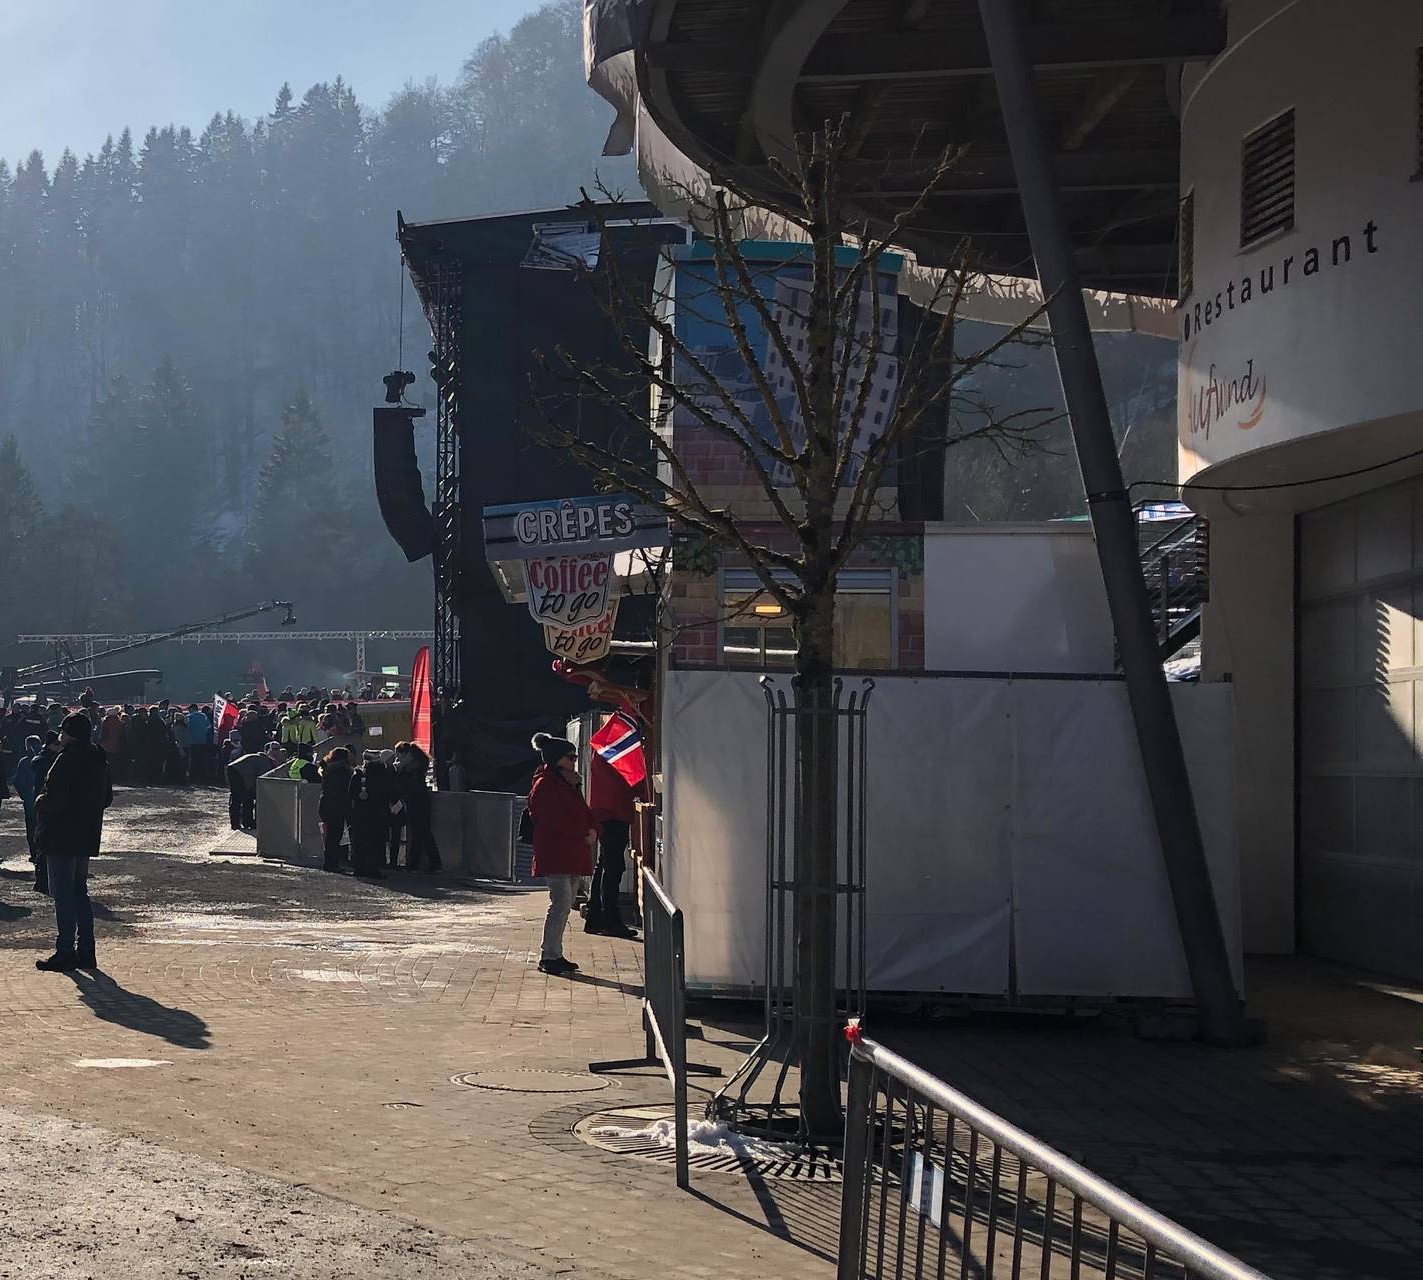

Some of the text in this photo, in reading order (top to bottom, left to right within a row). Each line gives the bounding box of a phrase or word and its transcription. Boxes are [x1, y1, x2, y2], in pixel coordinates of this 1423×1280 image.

[1194, 219, 1378, 335] Restaurant
[516, 501, 635, 544] CRÊPES
[530, 557, 609, 594] Coffee
[539, 590, 600, 622] to go
[554, 632, 602, 658] to go
